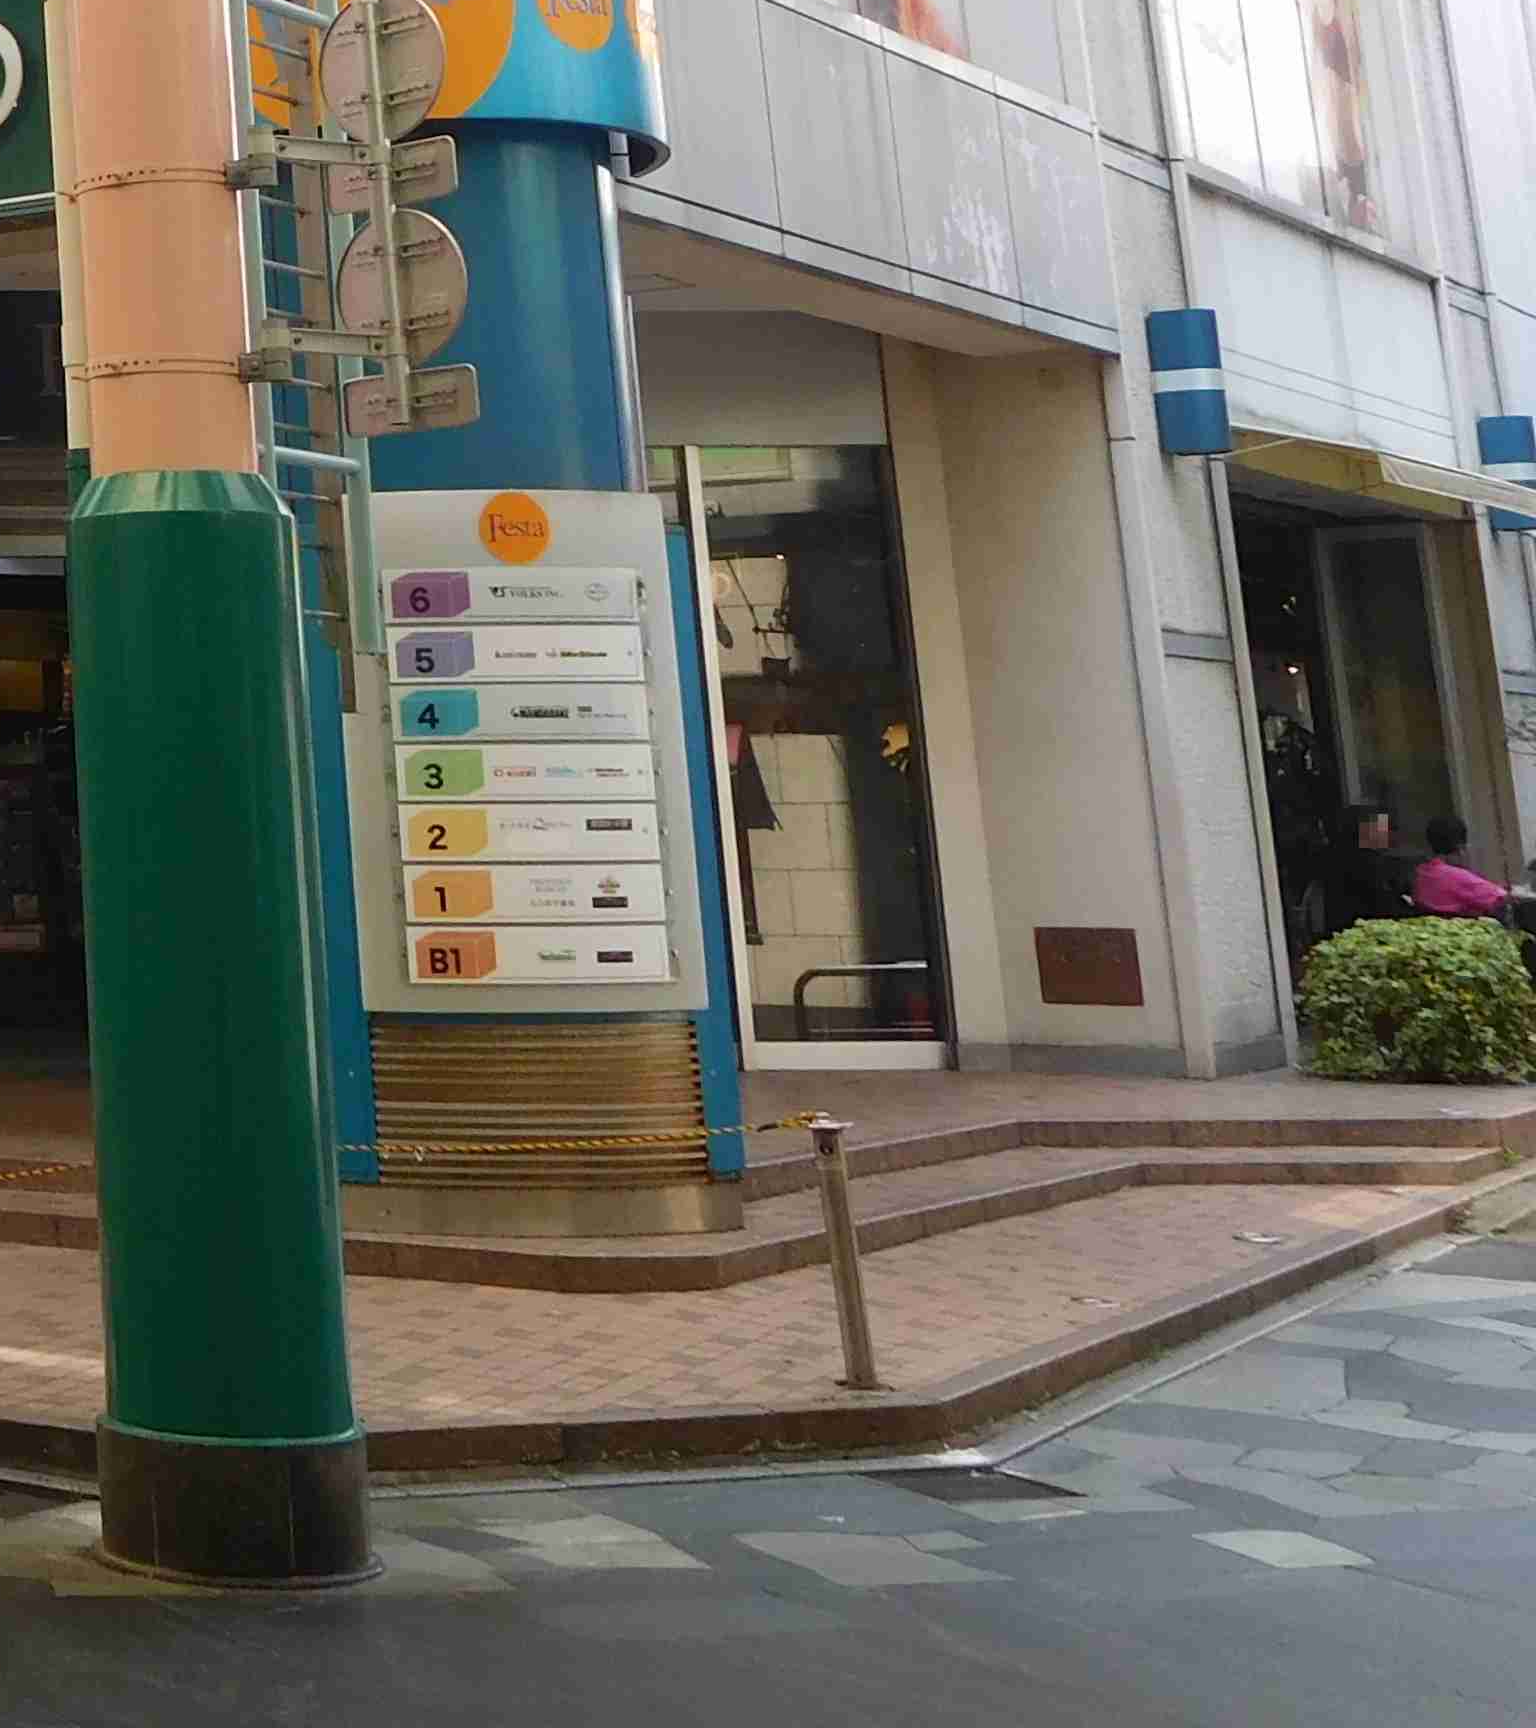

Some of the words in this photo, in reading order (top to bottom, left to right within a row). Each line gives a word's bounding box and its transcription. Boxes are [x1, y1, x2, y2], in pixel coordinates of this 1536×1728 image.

[488, 513, 546, 542] Festa
[410, 587, 430, 614] 6
[415, 647, 435, 675] 5
[417, 703, 439, 729] 4
[423, 764, 444, 790] 3
[428, 824, 447, 852] 2
[434, 885, 446, 913] 1
[430, 948, 463, 975] B1
